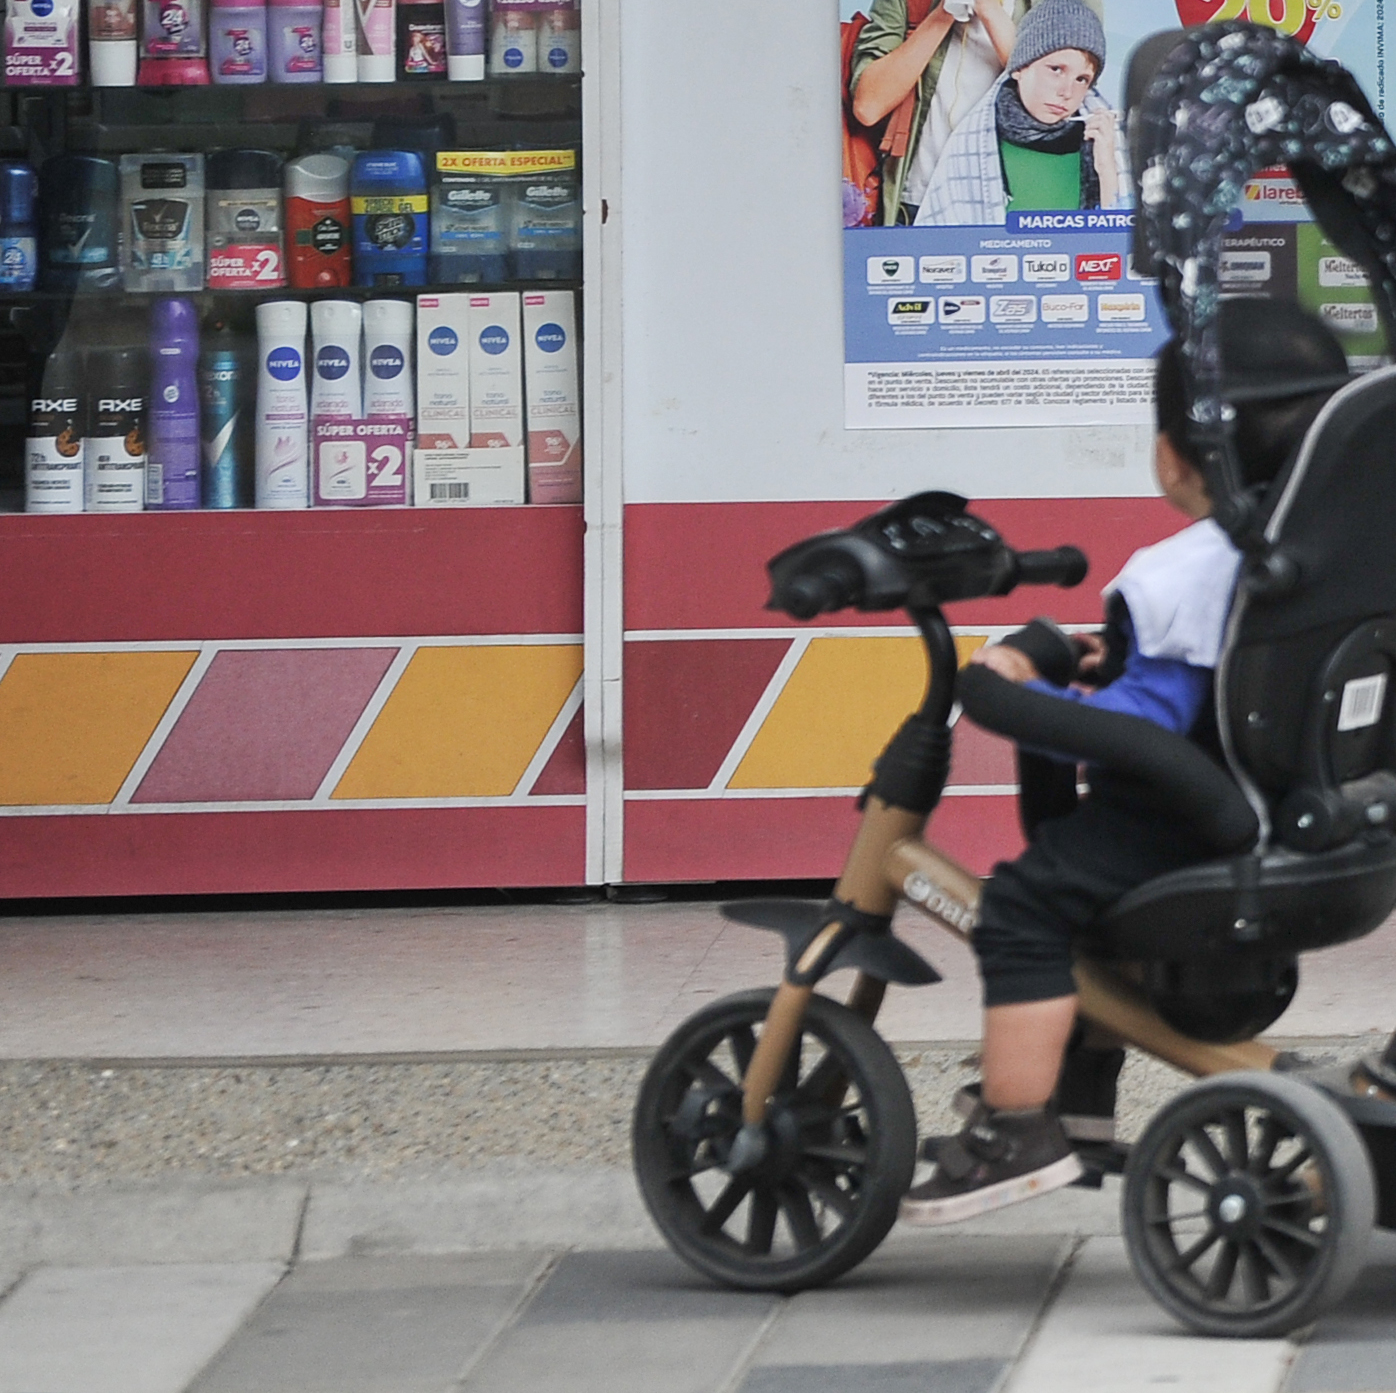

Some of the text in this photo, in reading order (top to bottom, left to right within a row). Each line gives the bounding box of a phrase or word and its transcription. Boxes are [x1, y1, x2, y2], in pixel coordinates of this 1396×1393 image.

[6, 53, 41, 65] SÚPER
[6, 66, 49, 76] OFERTA
[442, 156, 506, 167] 2X OFERTA
[448, 190, 491, 201] Gillette
[526, 186, 568, 197] Gillette
[1019, 215, 1084, 229] MARCAS
[980, 240, 1051, 249] MEDICAMENTO
[211, 257, 245, 267] SÚPER
[1024, 260, 1057, 273] Tukol
[211, 267, 251, 278] OFERTA
[430, 337, 456, 345] NIVEA
[481, 336, 507, 344] NIVEA
[537, 334, 563, 343] NIVEA
[268, 359, 300, 369] NIVEA
[317, 358, 347, 368] NIVEA
[371, 357, 403, 367] NIVEA
[31, 398, 78, 412] AXE
[98, 398, 143, 412] AXE
[316, 423, 403, 437] SÚPER OFERTA
